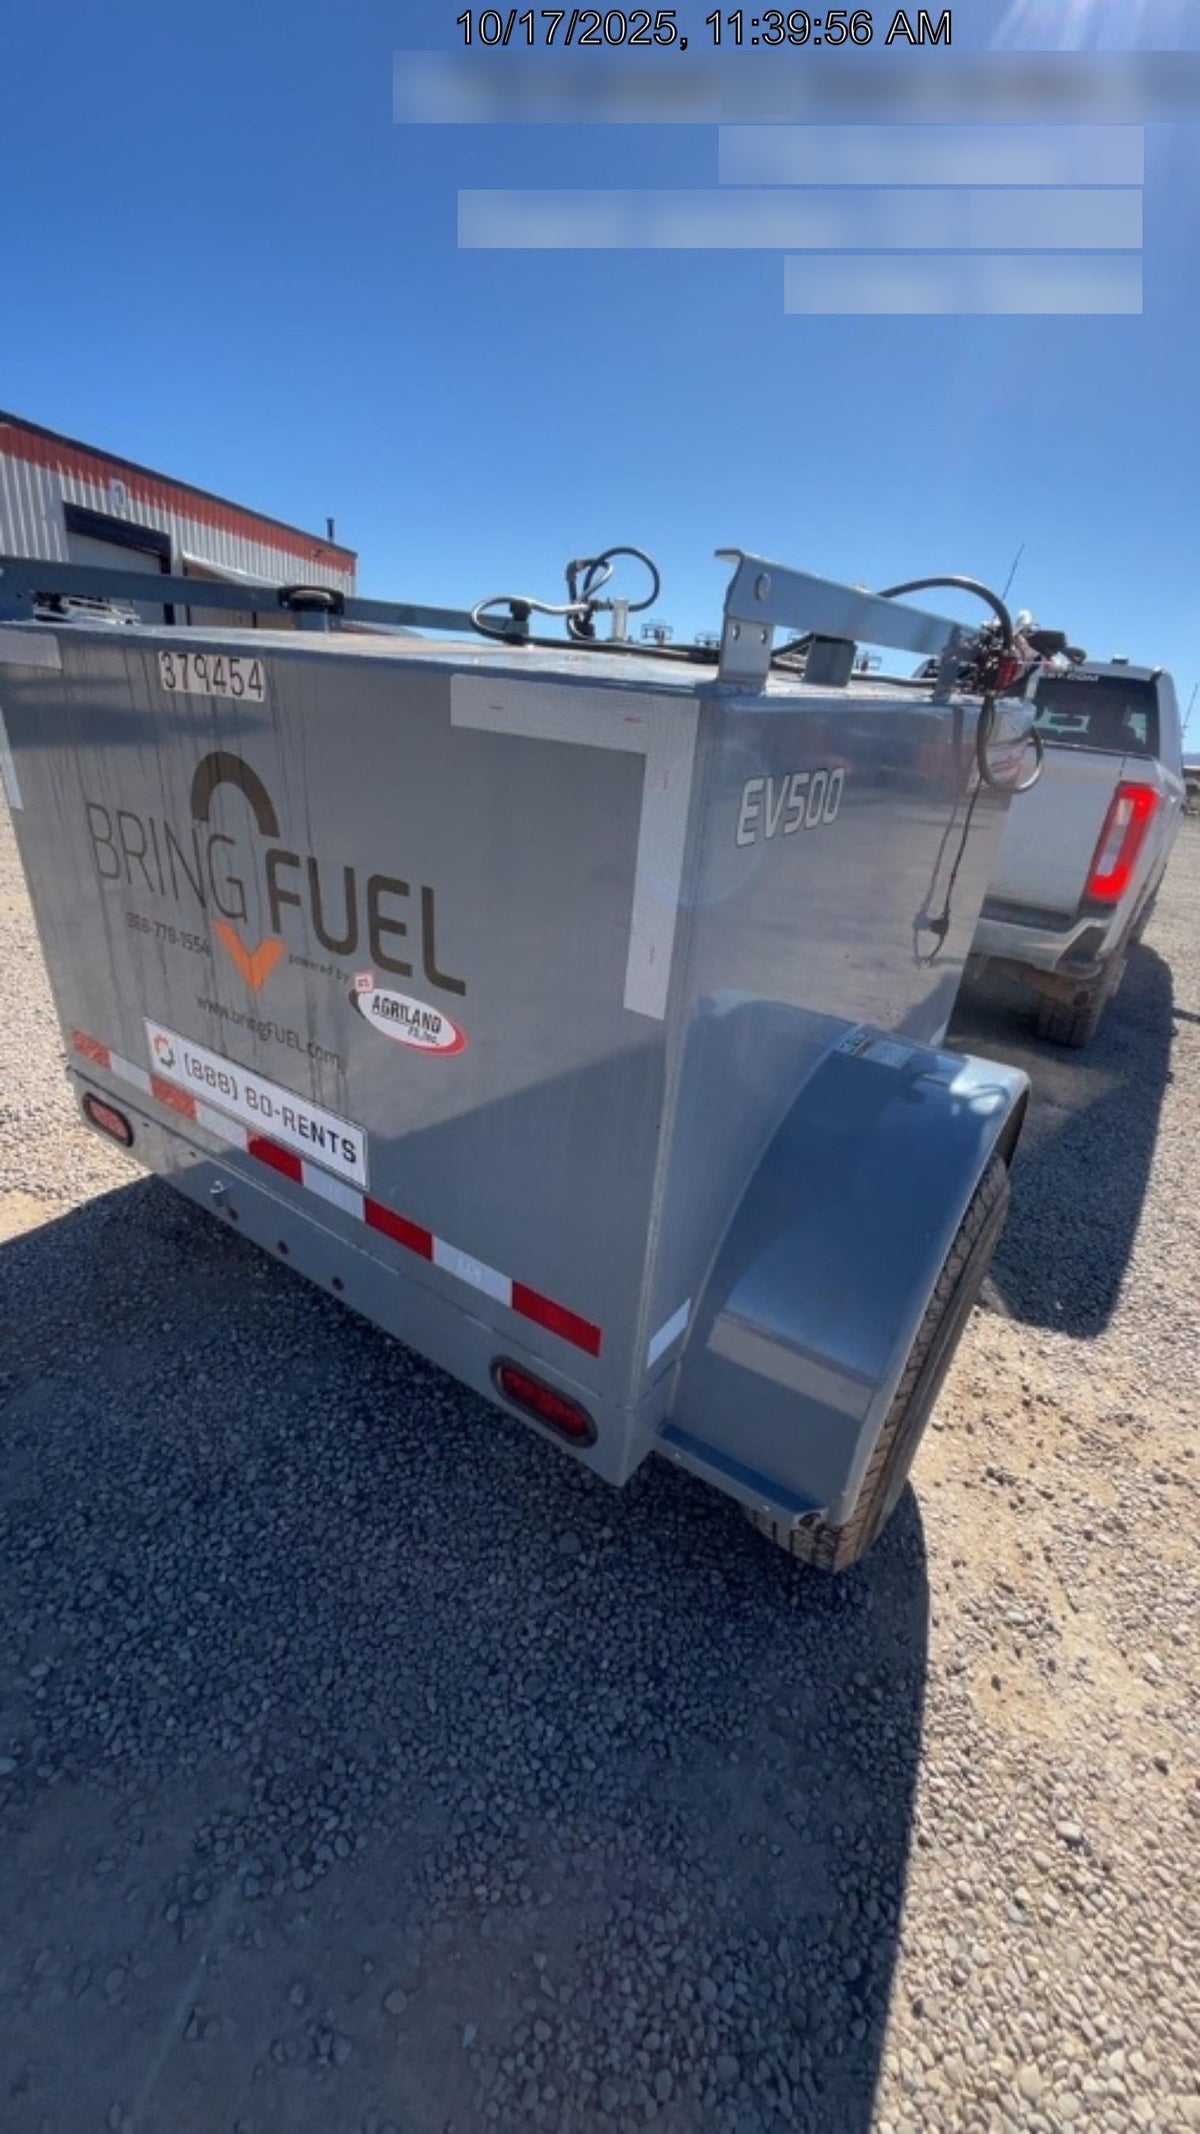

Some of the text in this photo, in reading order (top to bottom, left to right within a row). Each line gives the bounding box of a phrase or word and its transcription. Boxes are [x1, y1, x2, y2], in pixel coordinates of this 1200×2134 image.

[161, 651, 263, 699] 379454
[736, 766, 845, 847] EV500
[85, 802, 466, 996] BRING FUEL
[288, 952, 349, 985] powered by
[371, 994, 442, 1034] AGRILAND
[184, 1052, 357, 1164] (888) 80-RENTS
